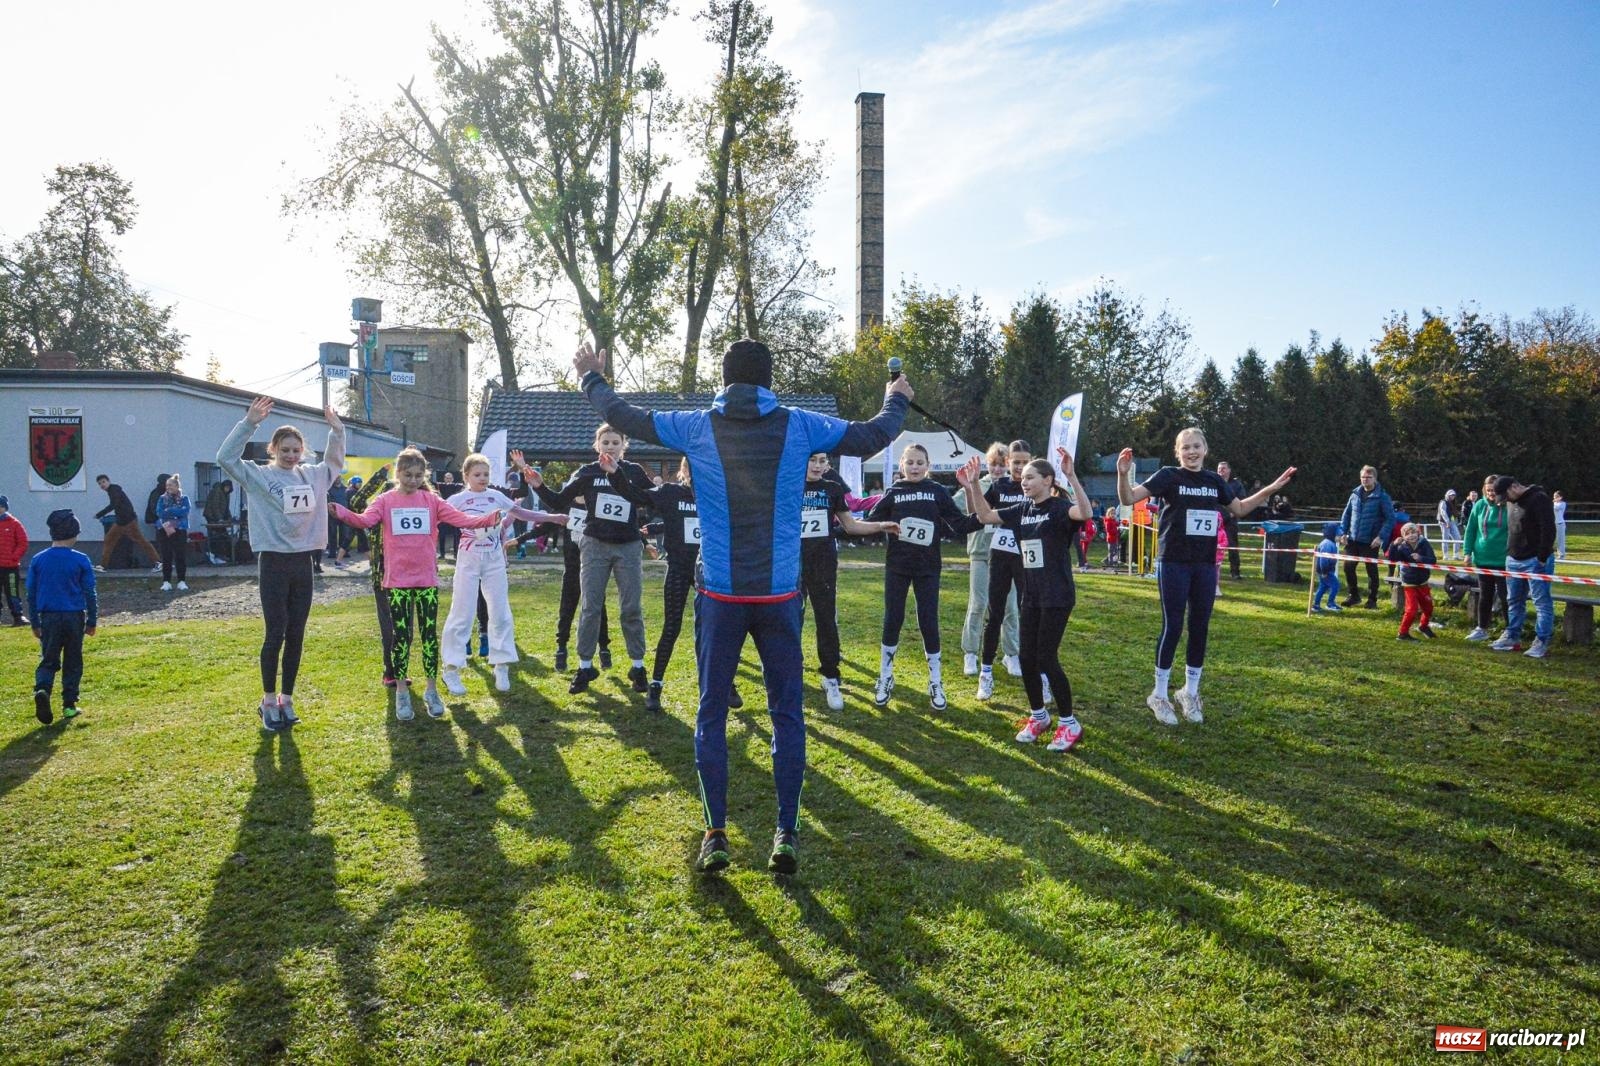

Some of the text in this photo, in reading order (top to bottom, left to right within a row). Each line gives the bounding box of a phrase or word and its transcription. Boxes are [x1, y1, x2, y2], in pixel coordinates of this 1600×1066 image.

[327, 368, 348, 377] START
[391, 374, 414, 383] GOŚCIE
[894, 491, 936, 504] HANDBALL
[1178, 485, 1219, 498] HANDBALL
[291, 494, 309, 508] 71
[602, 503, 623, 517] 82
[400, 517, 423, 529] 69
[801, 519, 820, 533] 72
[1194, 519, 1212, 531] 75
[906, 526, 926, 540] 78
[998, 535, 1016, 548] 83
